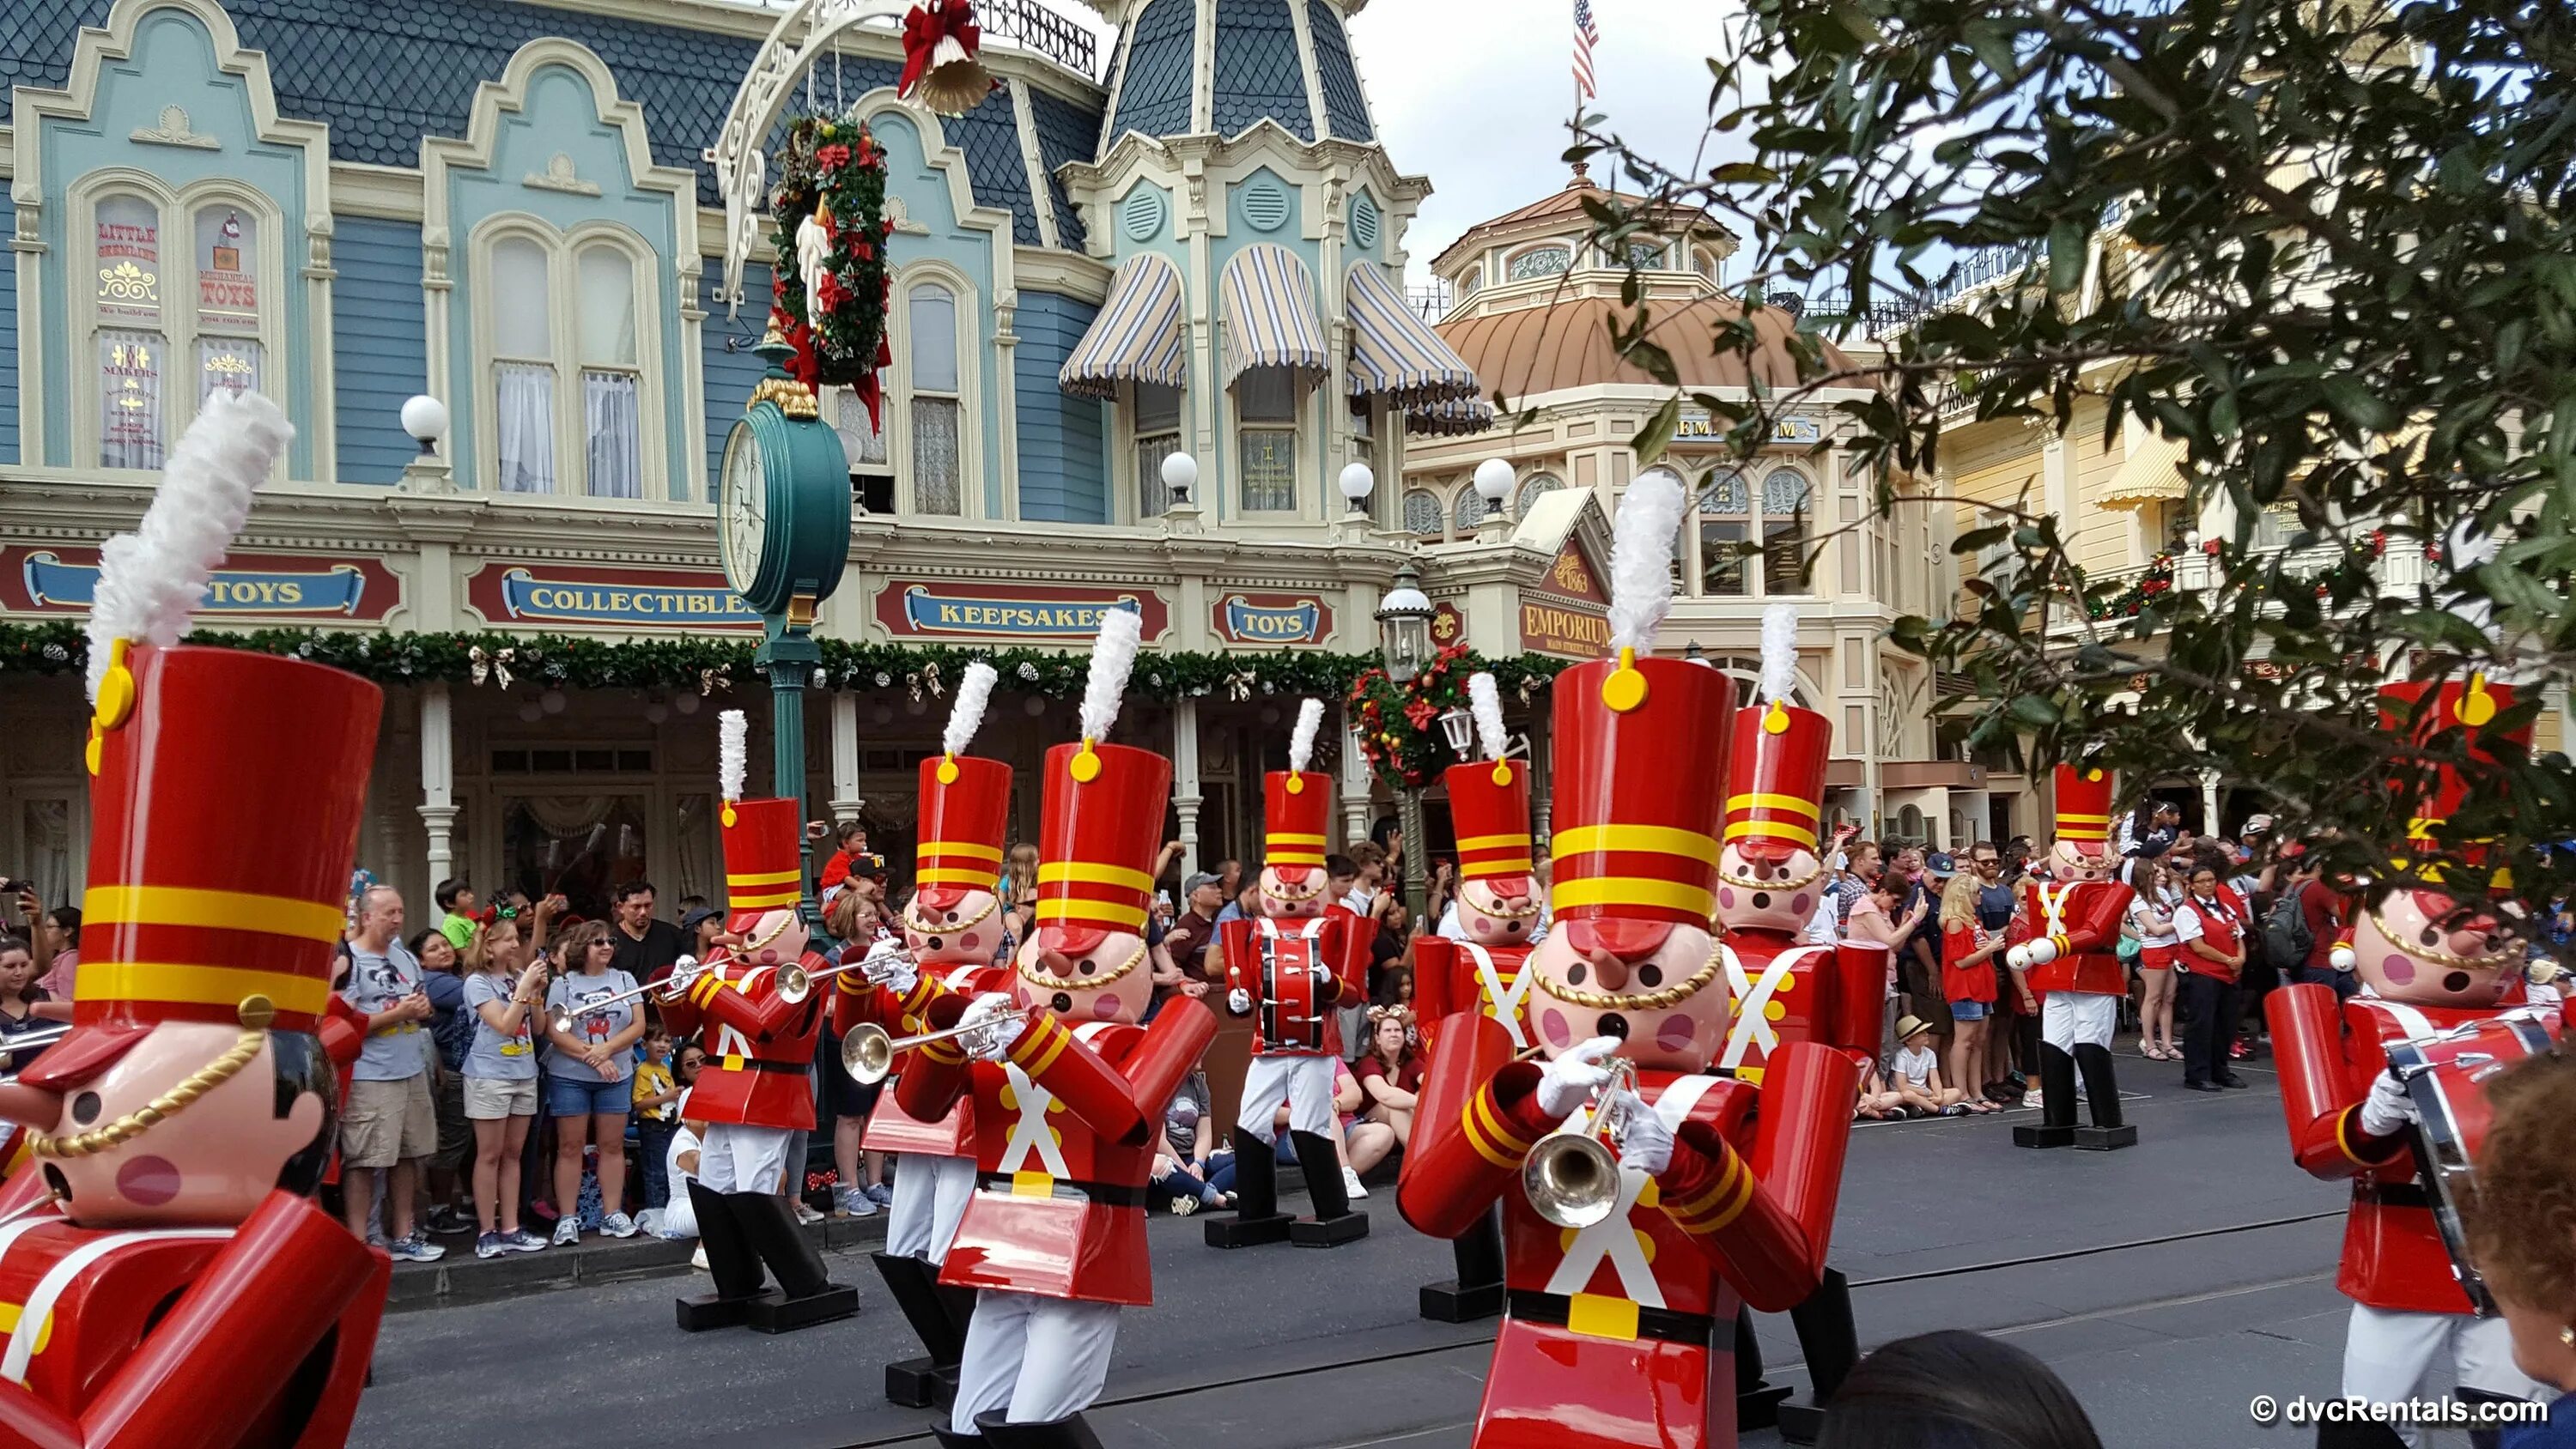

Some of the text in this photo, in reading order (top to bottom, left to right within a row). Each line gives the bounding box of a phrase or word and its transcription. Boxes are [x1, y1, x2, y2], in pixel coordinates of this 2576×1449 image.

[199, 281, 255, 307] TOYS
[206, 581, 303, 604] TOYS
[1566, 569, 1588, 593] 1863
[530, 588, 757, 615] COLLECTIBLE
[1242, 613, 1303, 634] TOYS
